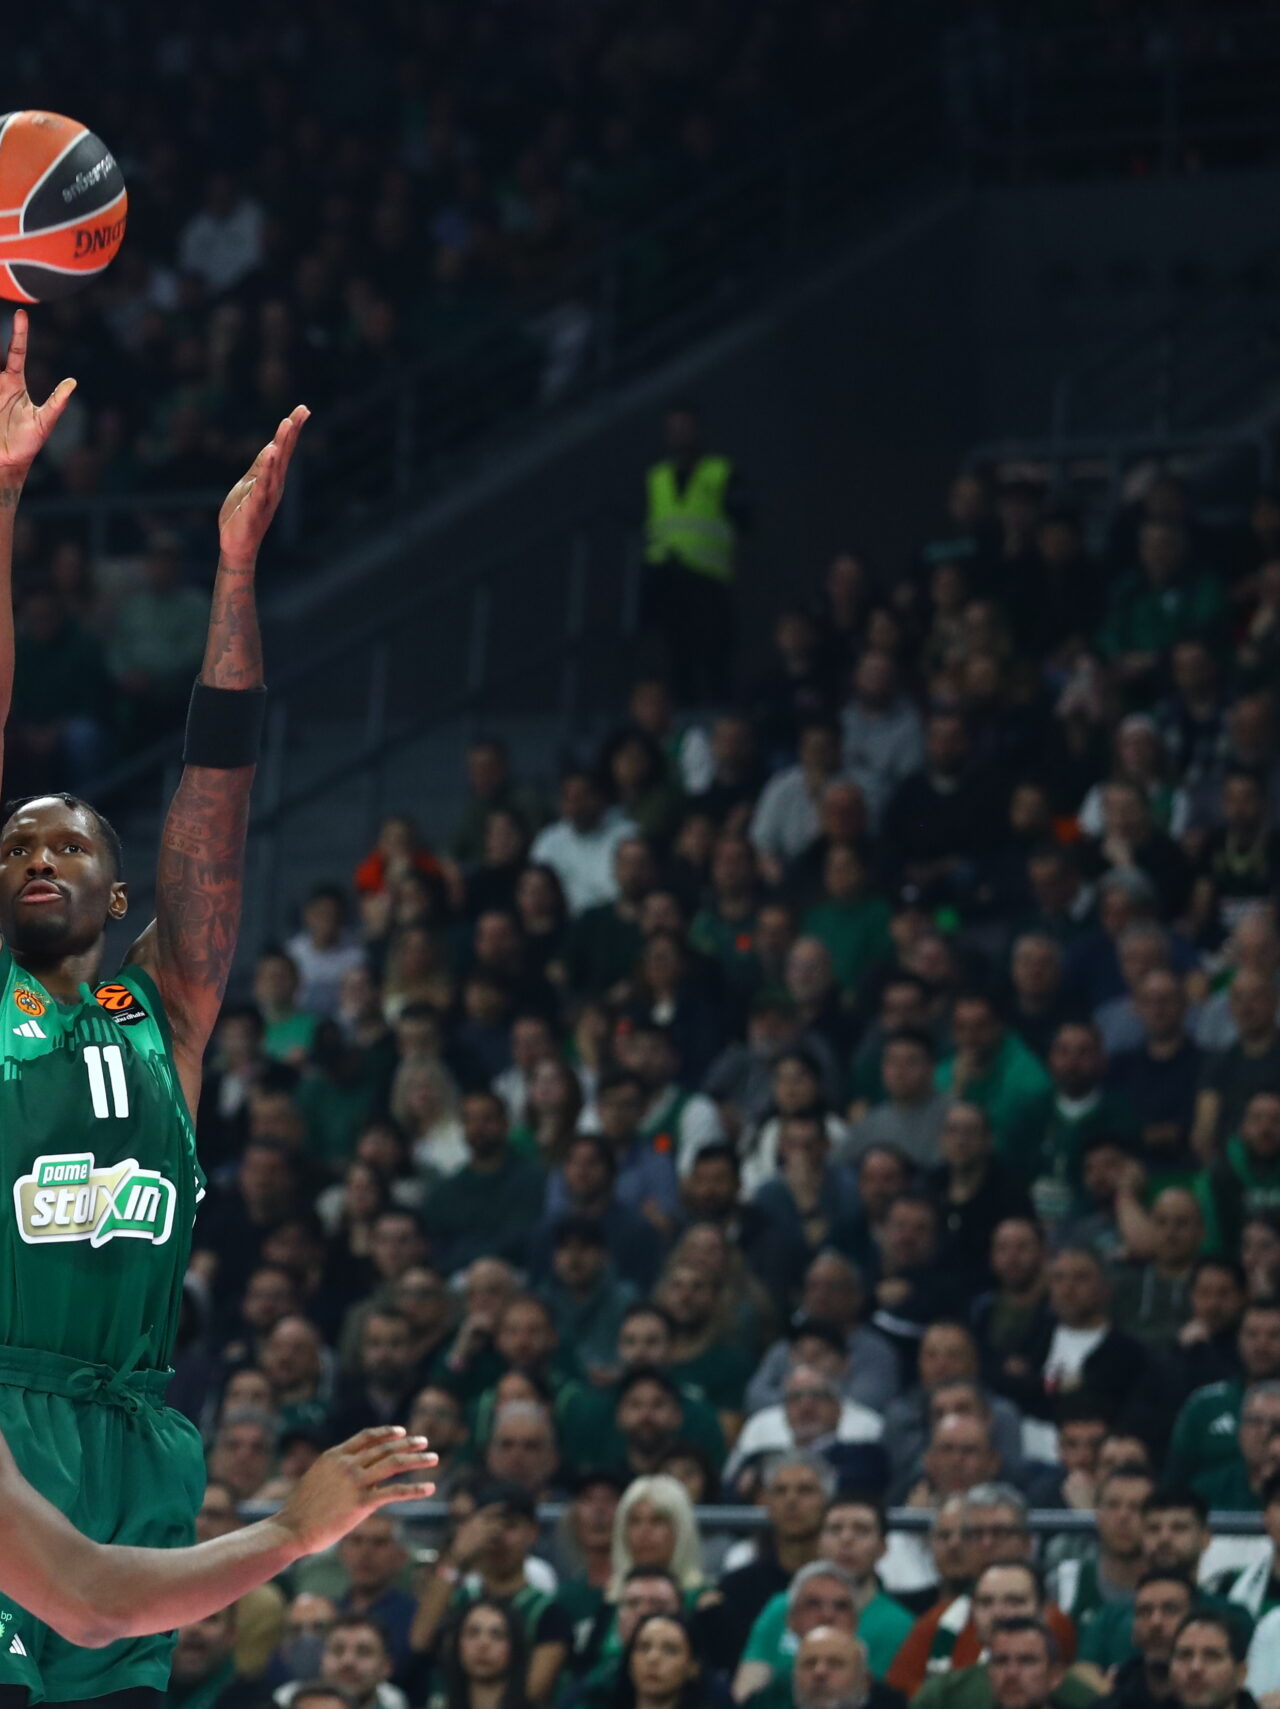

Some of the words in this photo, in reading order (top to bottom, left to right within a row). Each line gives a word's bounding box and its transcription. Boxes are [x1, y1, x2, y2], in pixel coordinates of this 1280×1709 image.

[83, 1045, 129, 1118] 11
[43, 1164, 88, 1183] pame
[0, 1610, 13, 1622] bp
